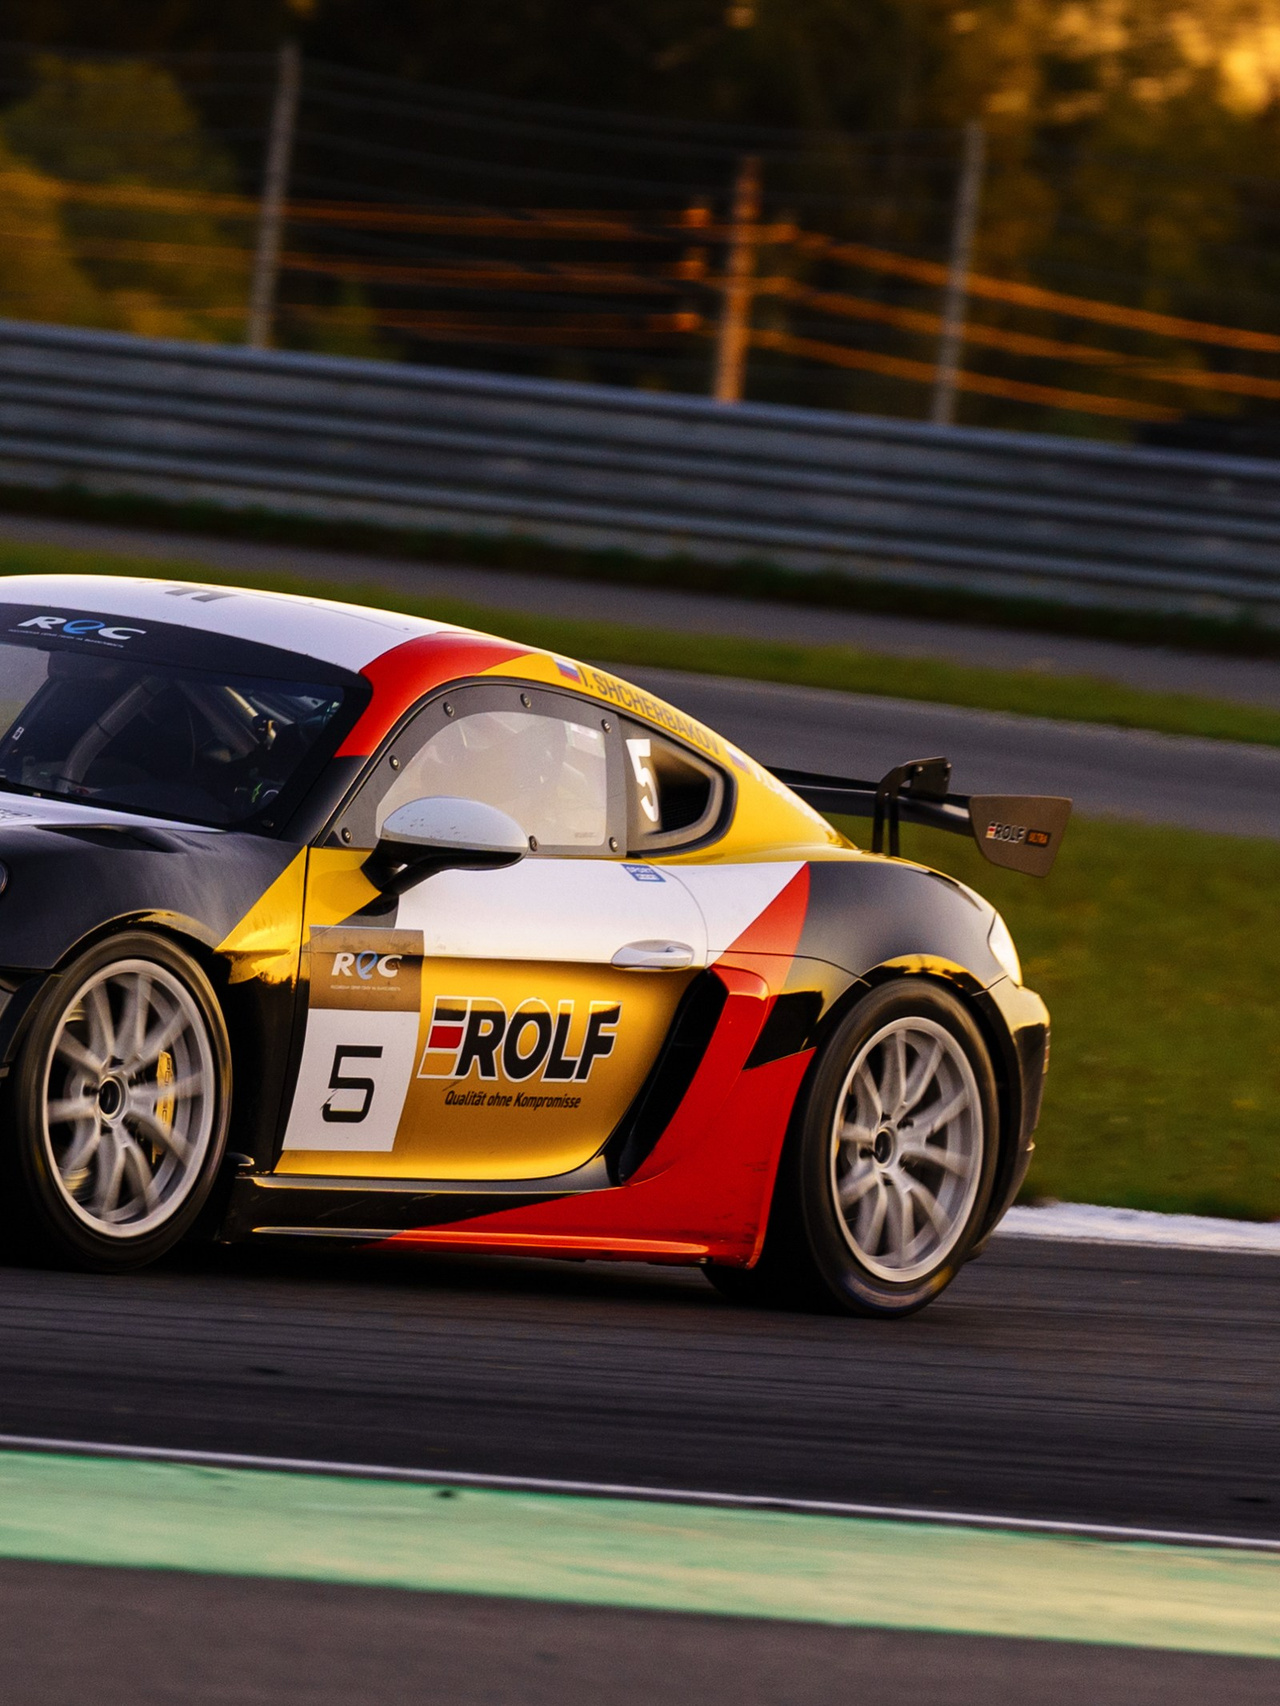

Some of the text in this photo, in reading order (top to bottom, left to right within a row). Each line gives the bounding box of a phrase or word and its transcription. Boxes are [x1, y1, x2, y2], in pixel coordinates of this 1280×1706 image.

[592, 672, 720, 755] SHCHERBAKOV
[625, 738, 659, 822] 5
[995, 822, 1027, 843] ROLF
[453, 997, 622, 1083] ROLF
[322, 1045, 383, 1123] 5
[444, 1090, 581, 1111] Qualität ohne Kompromisse
